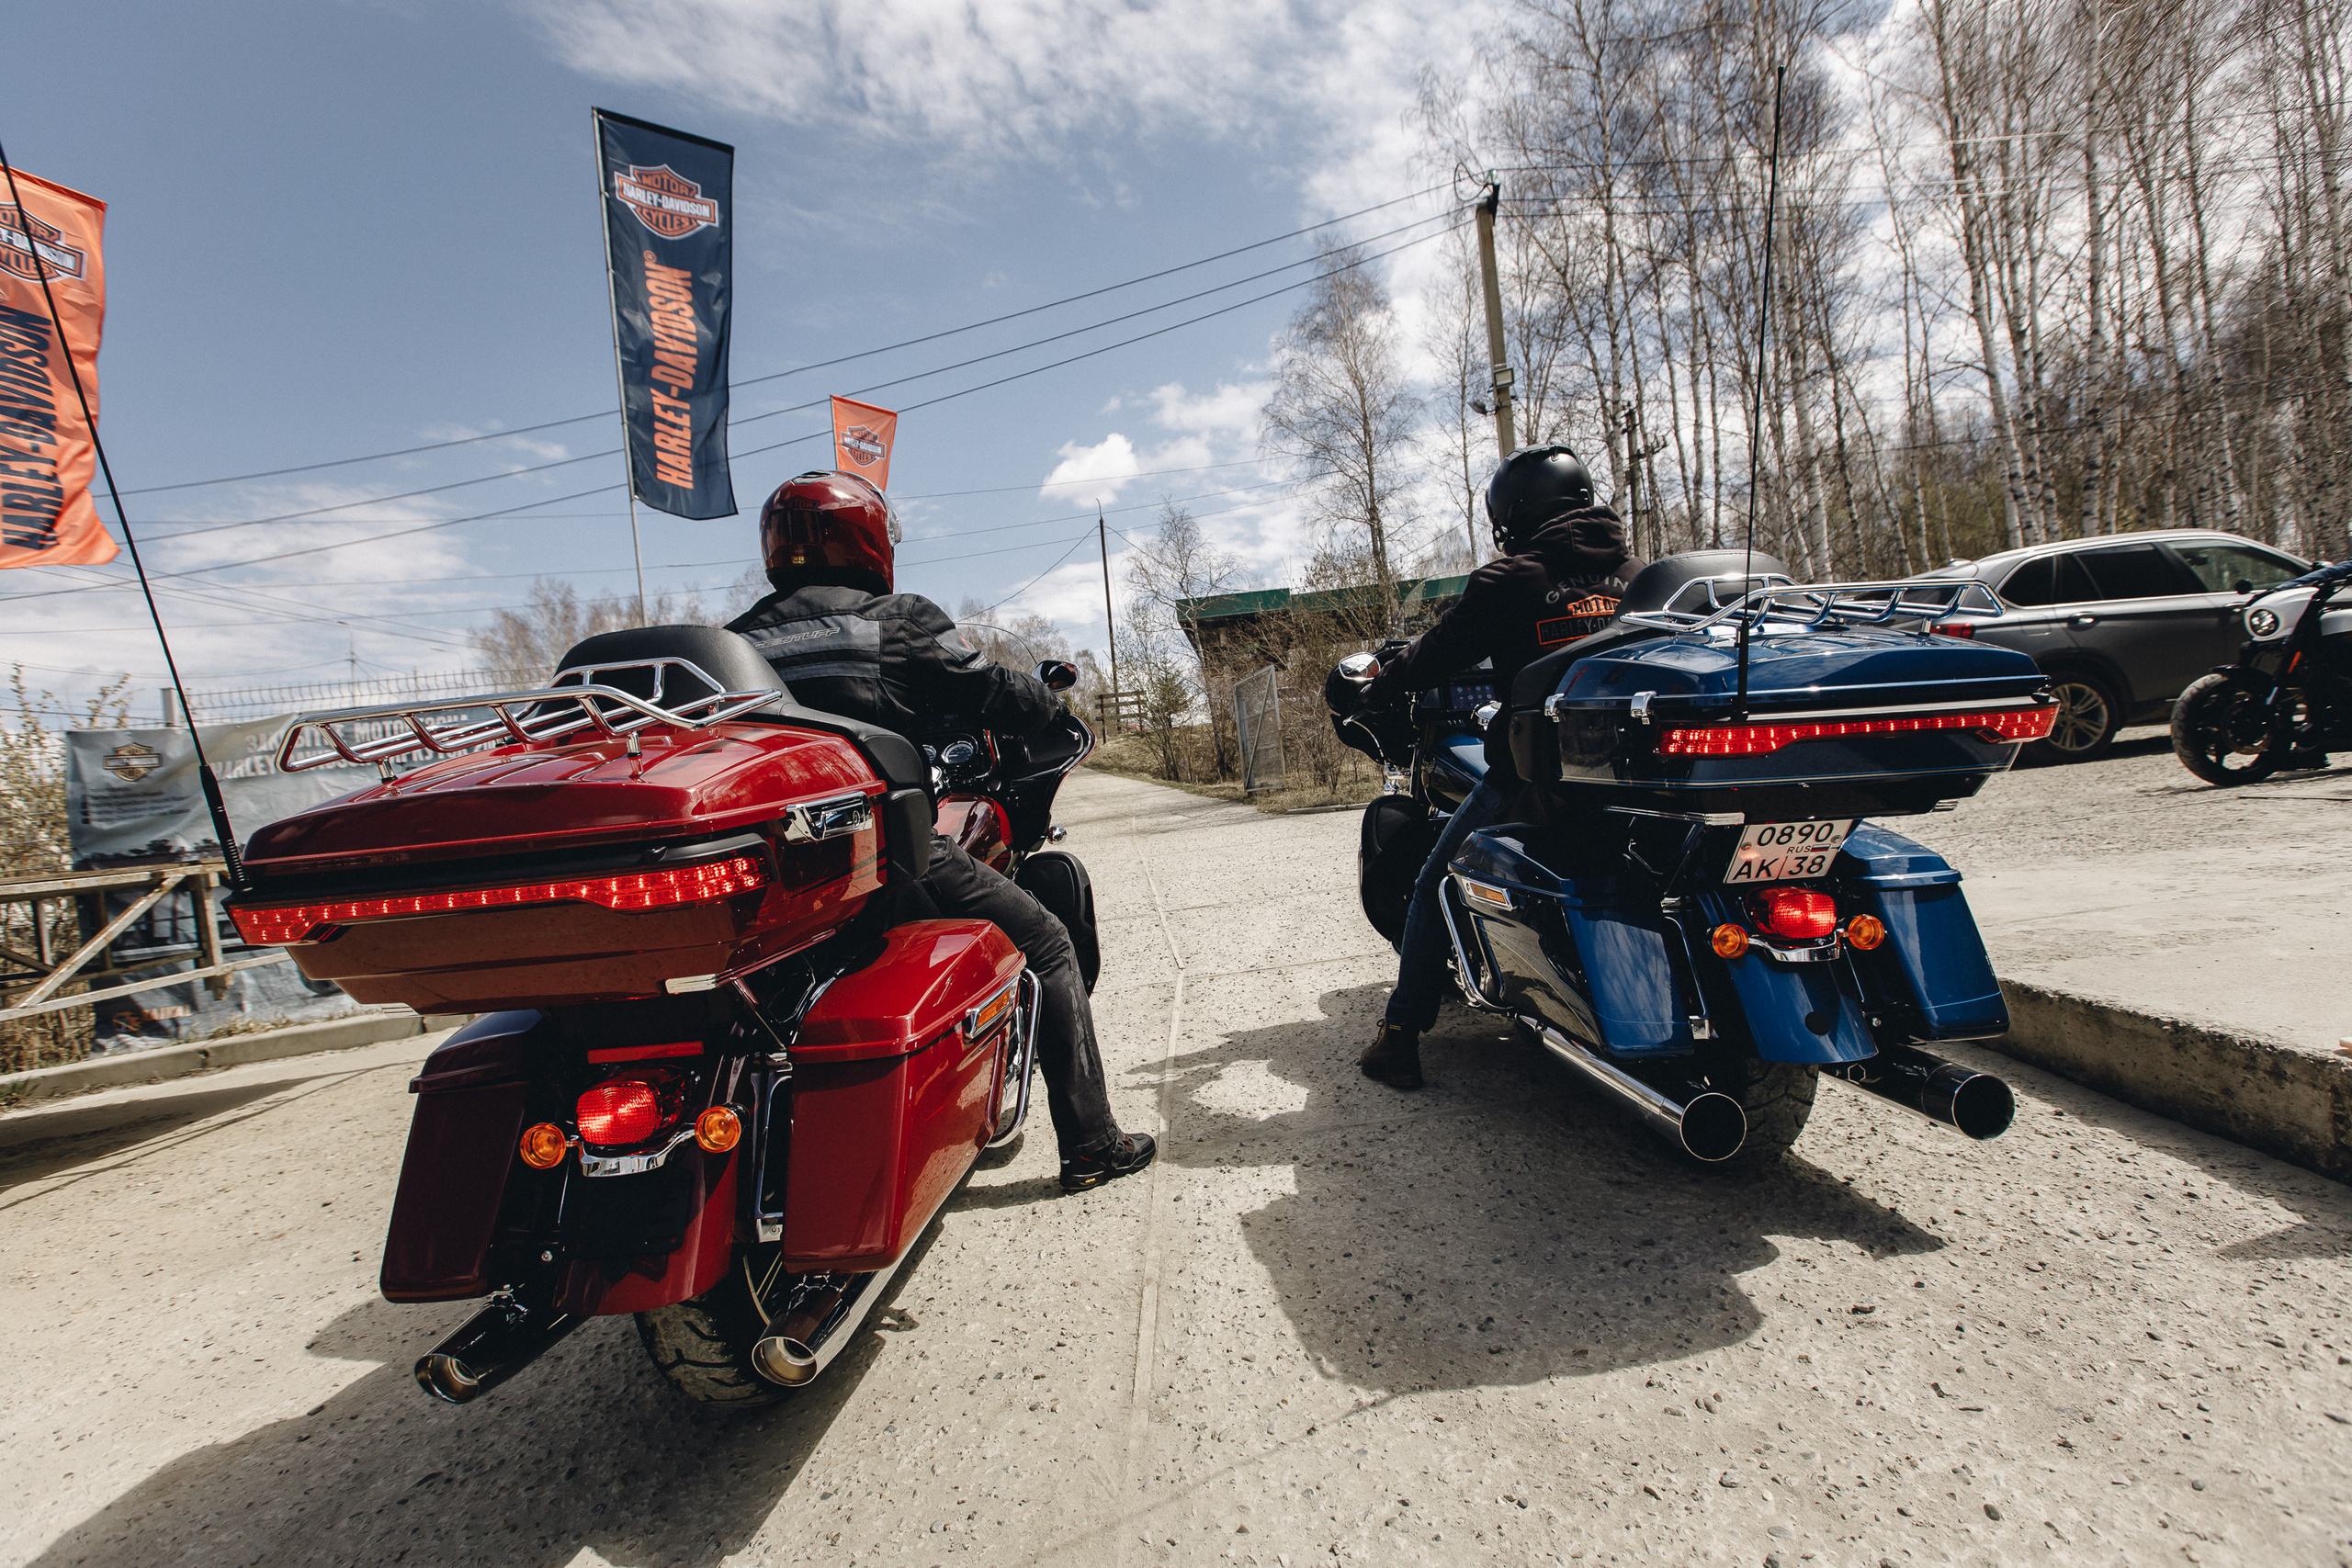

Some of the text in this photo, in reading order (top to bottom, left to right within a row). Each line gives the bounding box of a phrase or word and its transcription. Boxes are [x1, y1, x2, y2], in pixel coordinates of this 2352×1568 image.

[641, 174, 689, 196] MOTOR
[623, 181, 710, 219] HARLEY-DAVIDSON
[642, 209, 689, 231] CYCLES
[643, 262, 697, 490] HARLEY-DAVIDSON
[1541, 616, 1611, 640] HARLEY-D
[1757, 822, 1835, 847] 0890
[1786, 845, 1811, 854] RUS
[1787, 855, 1826, 875] 38
